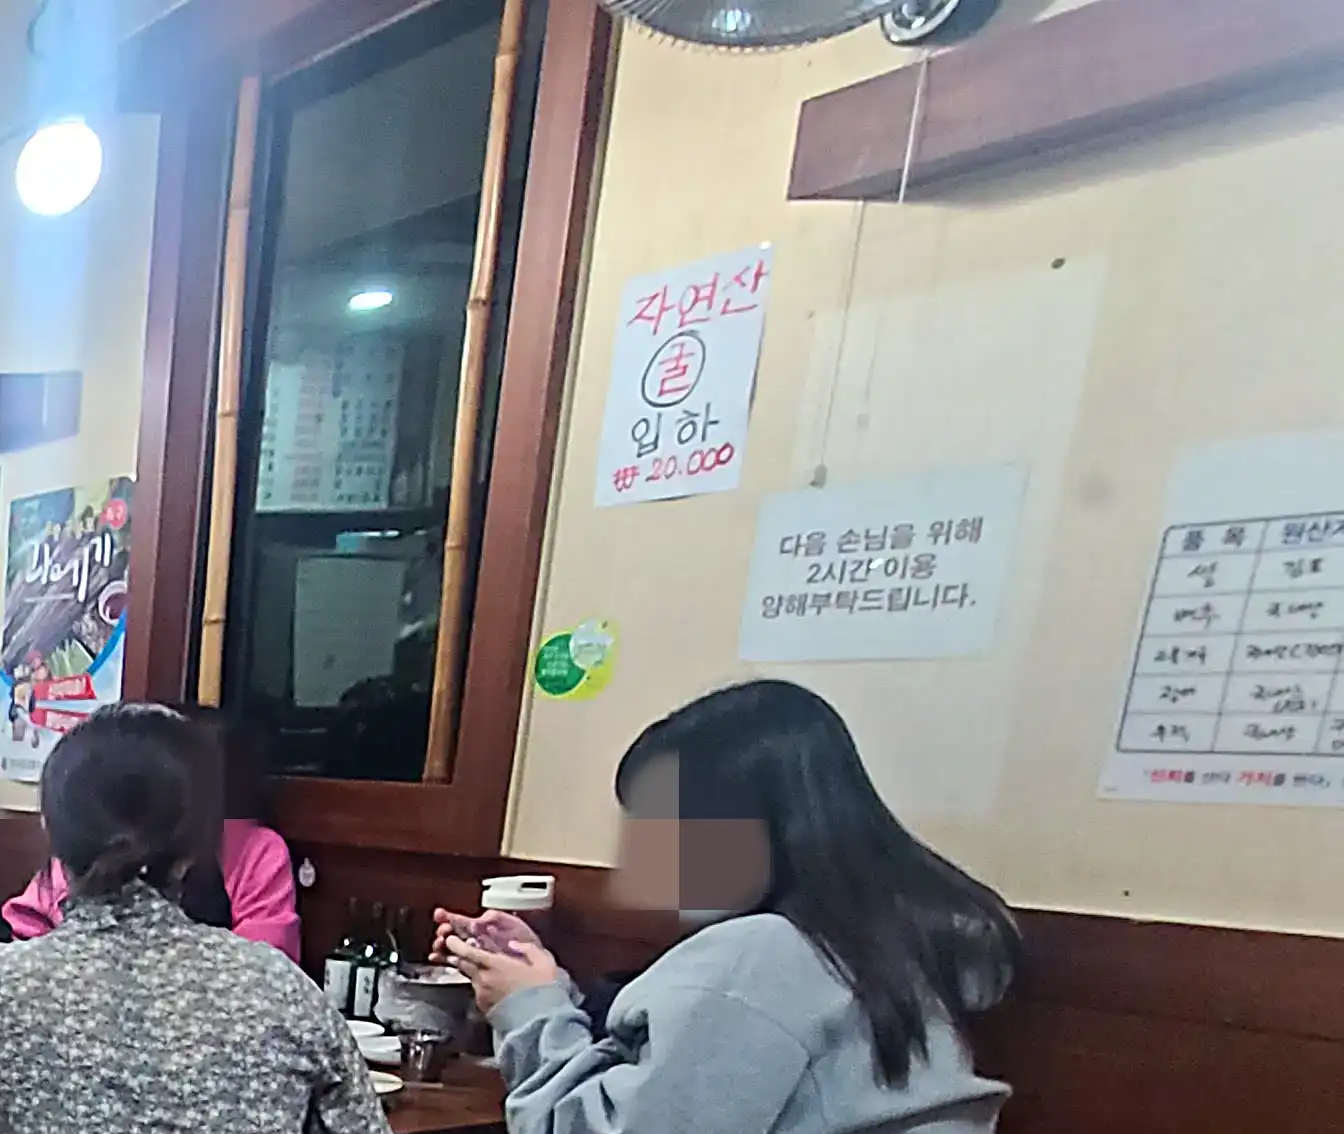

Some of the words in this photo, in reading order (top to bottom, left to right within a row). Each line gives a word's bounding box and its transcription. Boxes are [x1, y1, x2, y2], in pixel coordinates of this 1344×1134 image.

[627, 260, 769, 338] 자연산
[659, 342, 695, 399] 굴
[779, 531, 827, 558] 다음
[837, 524, 915, 554] 손님을
[927, 516, 984, 546] 위해
[806, 557, 872, 585] 2시간
[884, 553, 937, 581] 이용
